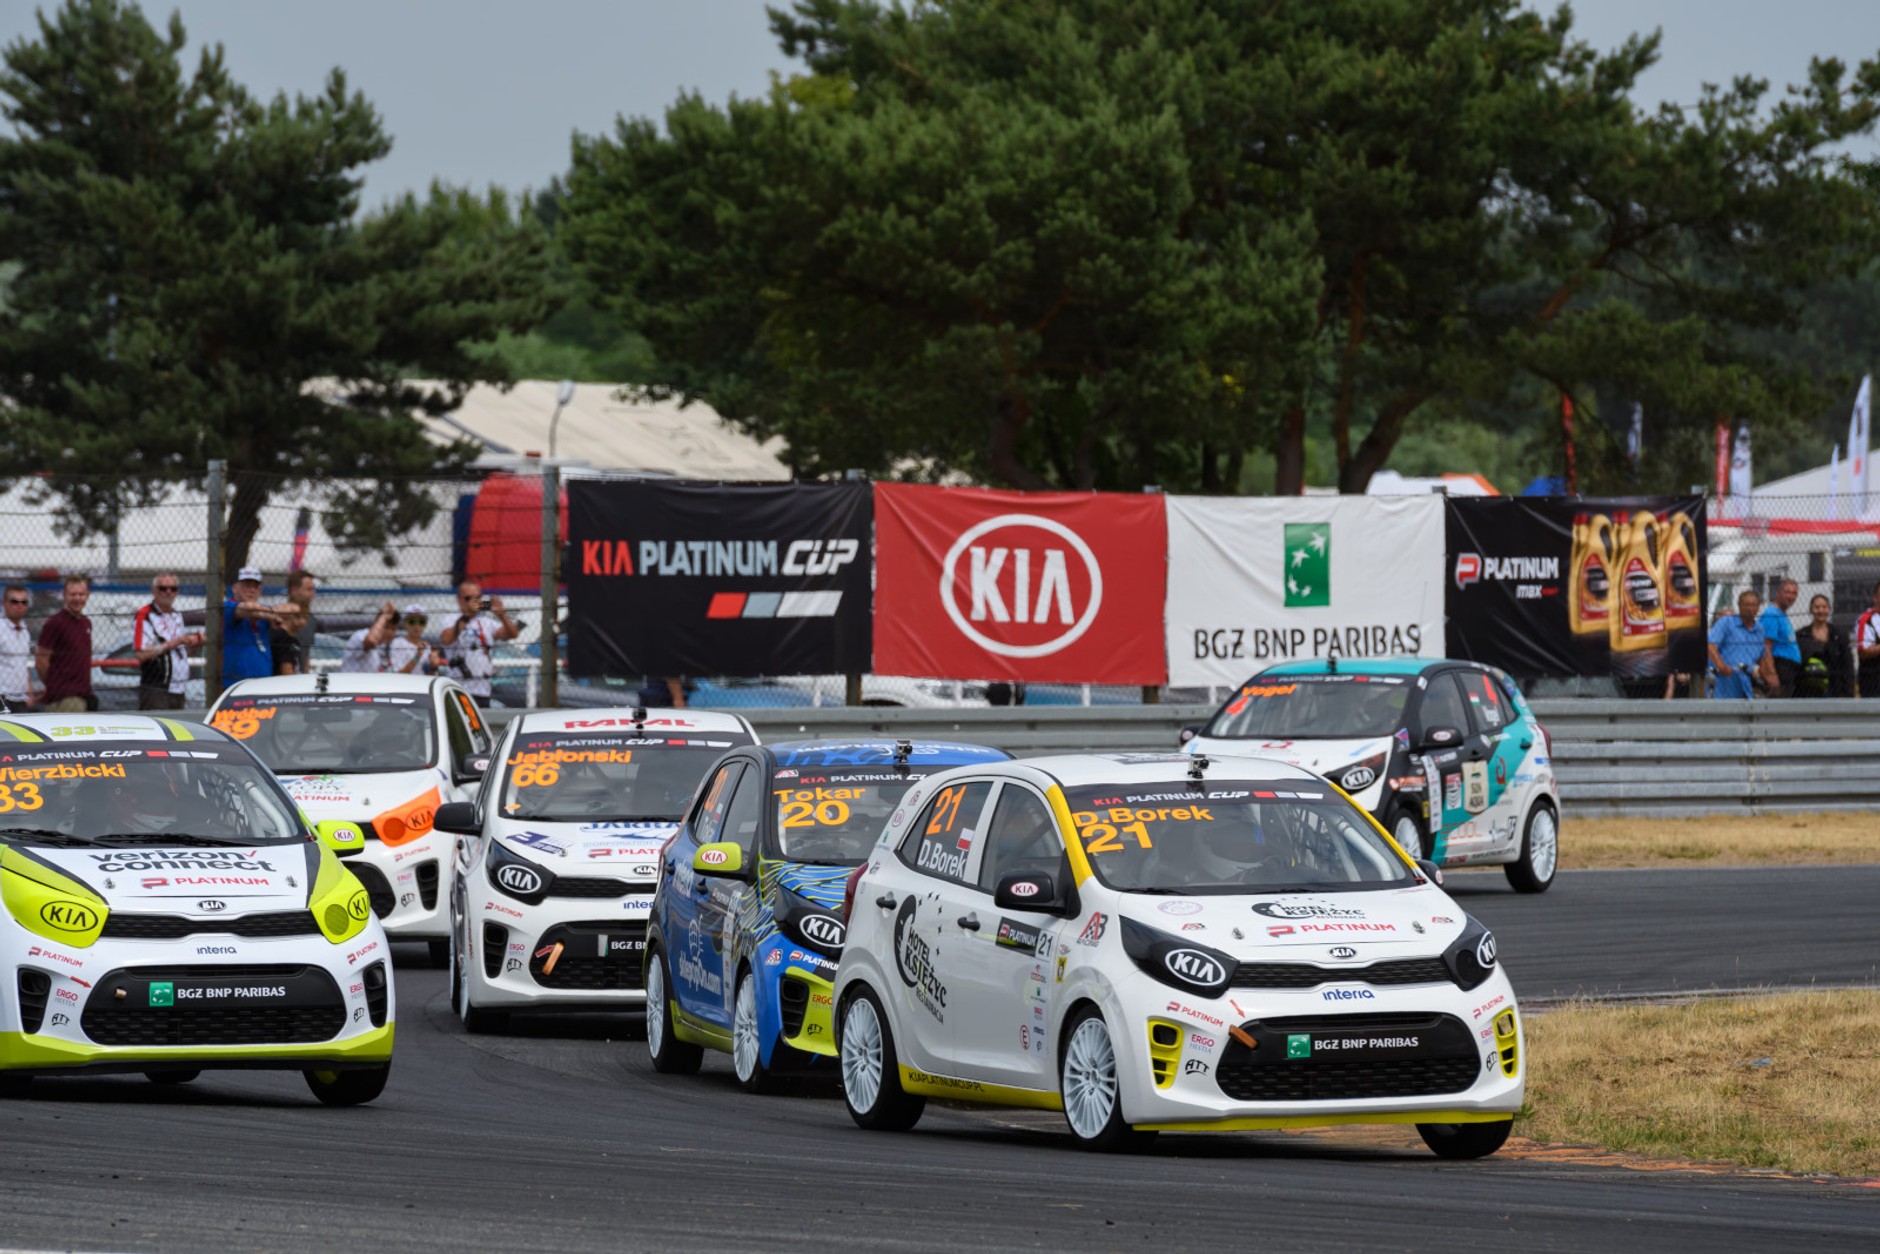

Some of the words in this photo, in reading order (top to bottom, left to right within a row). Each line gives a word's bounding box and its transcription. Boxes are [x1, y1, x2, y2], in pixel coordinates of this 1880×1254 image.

[582, 540, 634, 576] KIA
[639, 540, 778, 577] PLATINUM
[781, 539, 859, 576] CUP
[1484, 557, 1559, 580] PLATINUM
[970, 546, 1075, 625] KIA
[1516, 585, 1543, 599] max
[1254, 628, 1305, 659] BNP
[1313, 623, 1423, 658] PARIBAS
[51, 726, 96, 737] 33
[555, 739, 623, 747] PLATINUM
[624, 738, 665, 746] CUP
[17, 750, 96, 762] PLATINUM
[99, 750, 143, 758] CUP
[512, 763, 560, 788] 66
[800, 776, 827, 784] KIA
[830, 773, 902, 783] PLATINUM
[1350, 767, 1375, 785] KIA
[774, 786, 866, 803] Tokar
[1093, 797, 1124, 807] KIA
[1126, 792, 1205, 803] PLATINUM
[1207, 791, 1250, 800] CUP
[782, 800, 851, 829] 20
[925, 785, 967, 836] 21
[1072, 805, 1216, 828] D.Borek
[336, 829, 355, 841] KIA
[1081, 822, 1154, 855] 21
[88, 850, 242, 862] verizon
[619, 848, 661, 856] PLATI
[704, 852, 724, 863] KIA
[916, 839, 967, 879] D.Borek
[98, 859, 277, 873] connect
[635, 866, 656, 875] KIA
[174, 876, 270, 886] PLATINUM
[503, 868, 534, 890] KIA
[1015, 885, 1034, 894] KIA
[202, 900, 225, 910] KIA
[494, 904, 524, 919] PLATINUM
[50, 906, 87, 928] KIA
[807, 918, 840, 943] KIA
[1300, 923, 1397, 932] PLATINUM
[635, 941, 648, 950] BN
[1008, 928, 1038, 947] PLATINUM
[1037, 932, 1053, 957] 21
[42, 950, 84, 968] PLATINUM
[356, 941, 379, 961] PLATINUM
[1332, 948, 1354, 957] KIA
[1173, 952, 1215, 983] KIA
[56, 988, 79, 1002] ERGO
[206, 987, 232, 998] BNP
[234, 986, 286, 998] PARIBAS
[1482, 994, 1505, 1013] PLATINUM
[1181, 1006, 1225, 1028] PLATINUM
[1191, 1033, 1215, 1048] ERGO
[1342, 1038, 1368, 1050] BNP
[1369, 1036, 1419, 1049] PARIBAS
